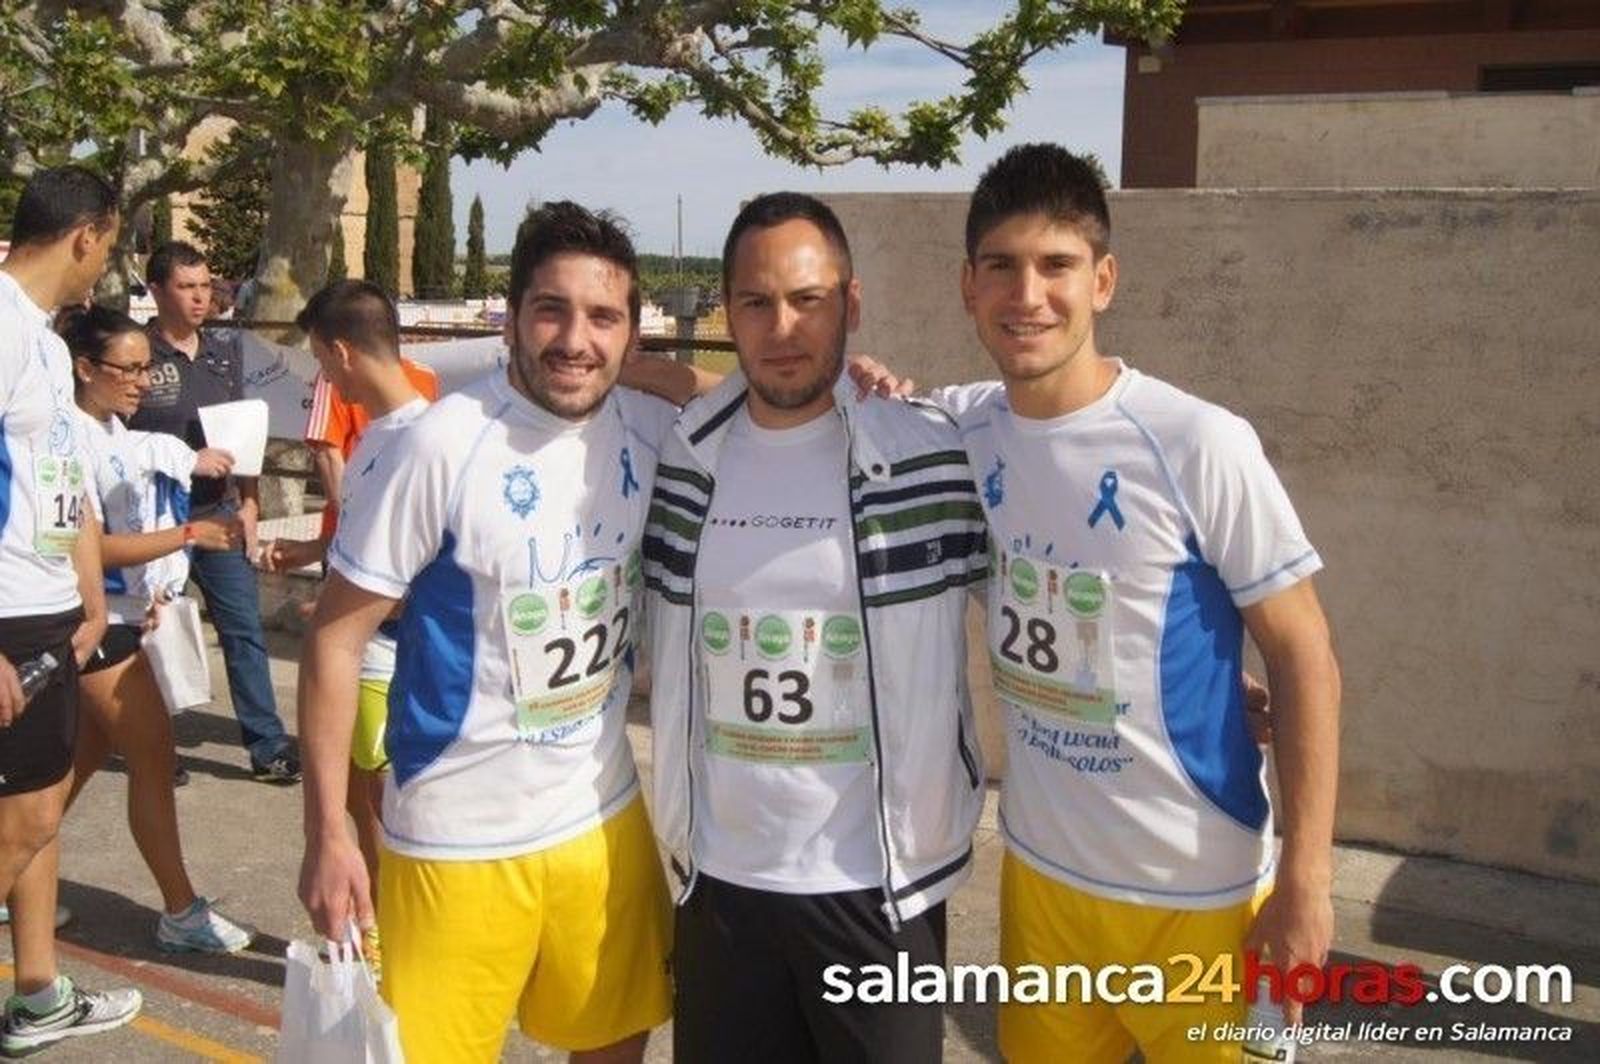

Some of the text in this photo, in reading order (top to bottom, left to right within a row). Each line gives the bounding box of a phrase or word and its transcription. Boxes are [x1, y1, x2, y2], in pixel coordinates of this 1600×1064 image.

[543, 606, 629, 690] 222
[1000, 605, 1060, 674] 28
[743, 668, 814, 725] 63
